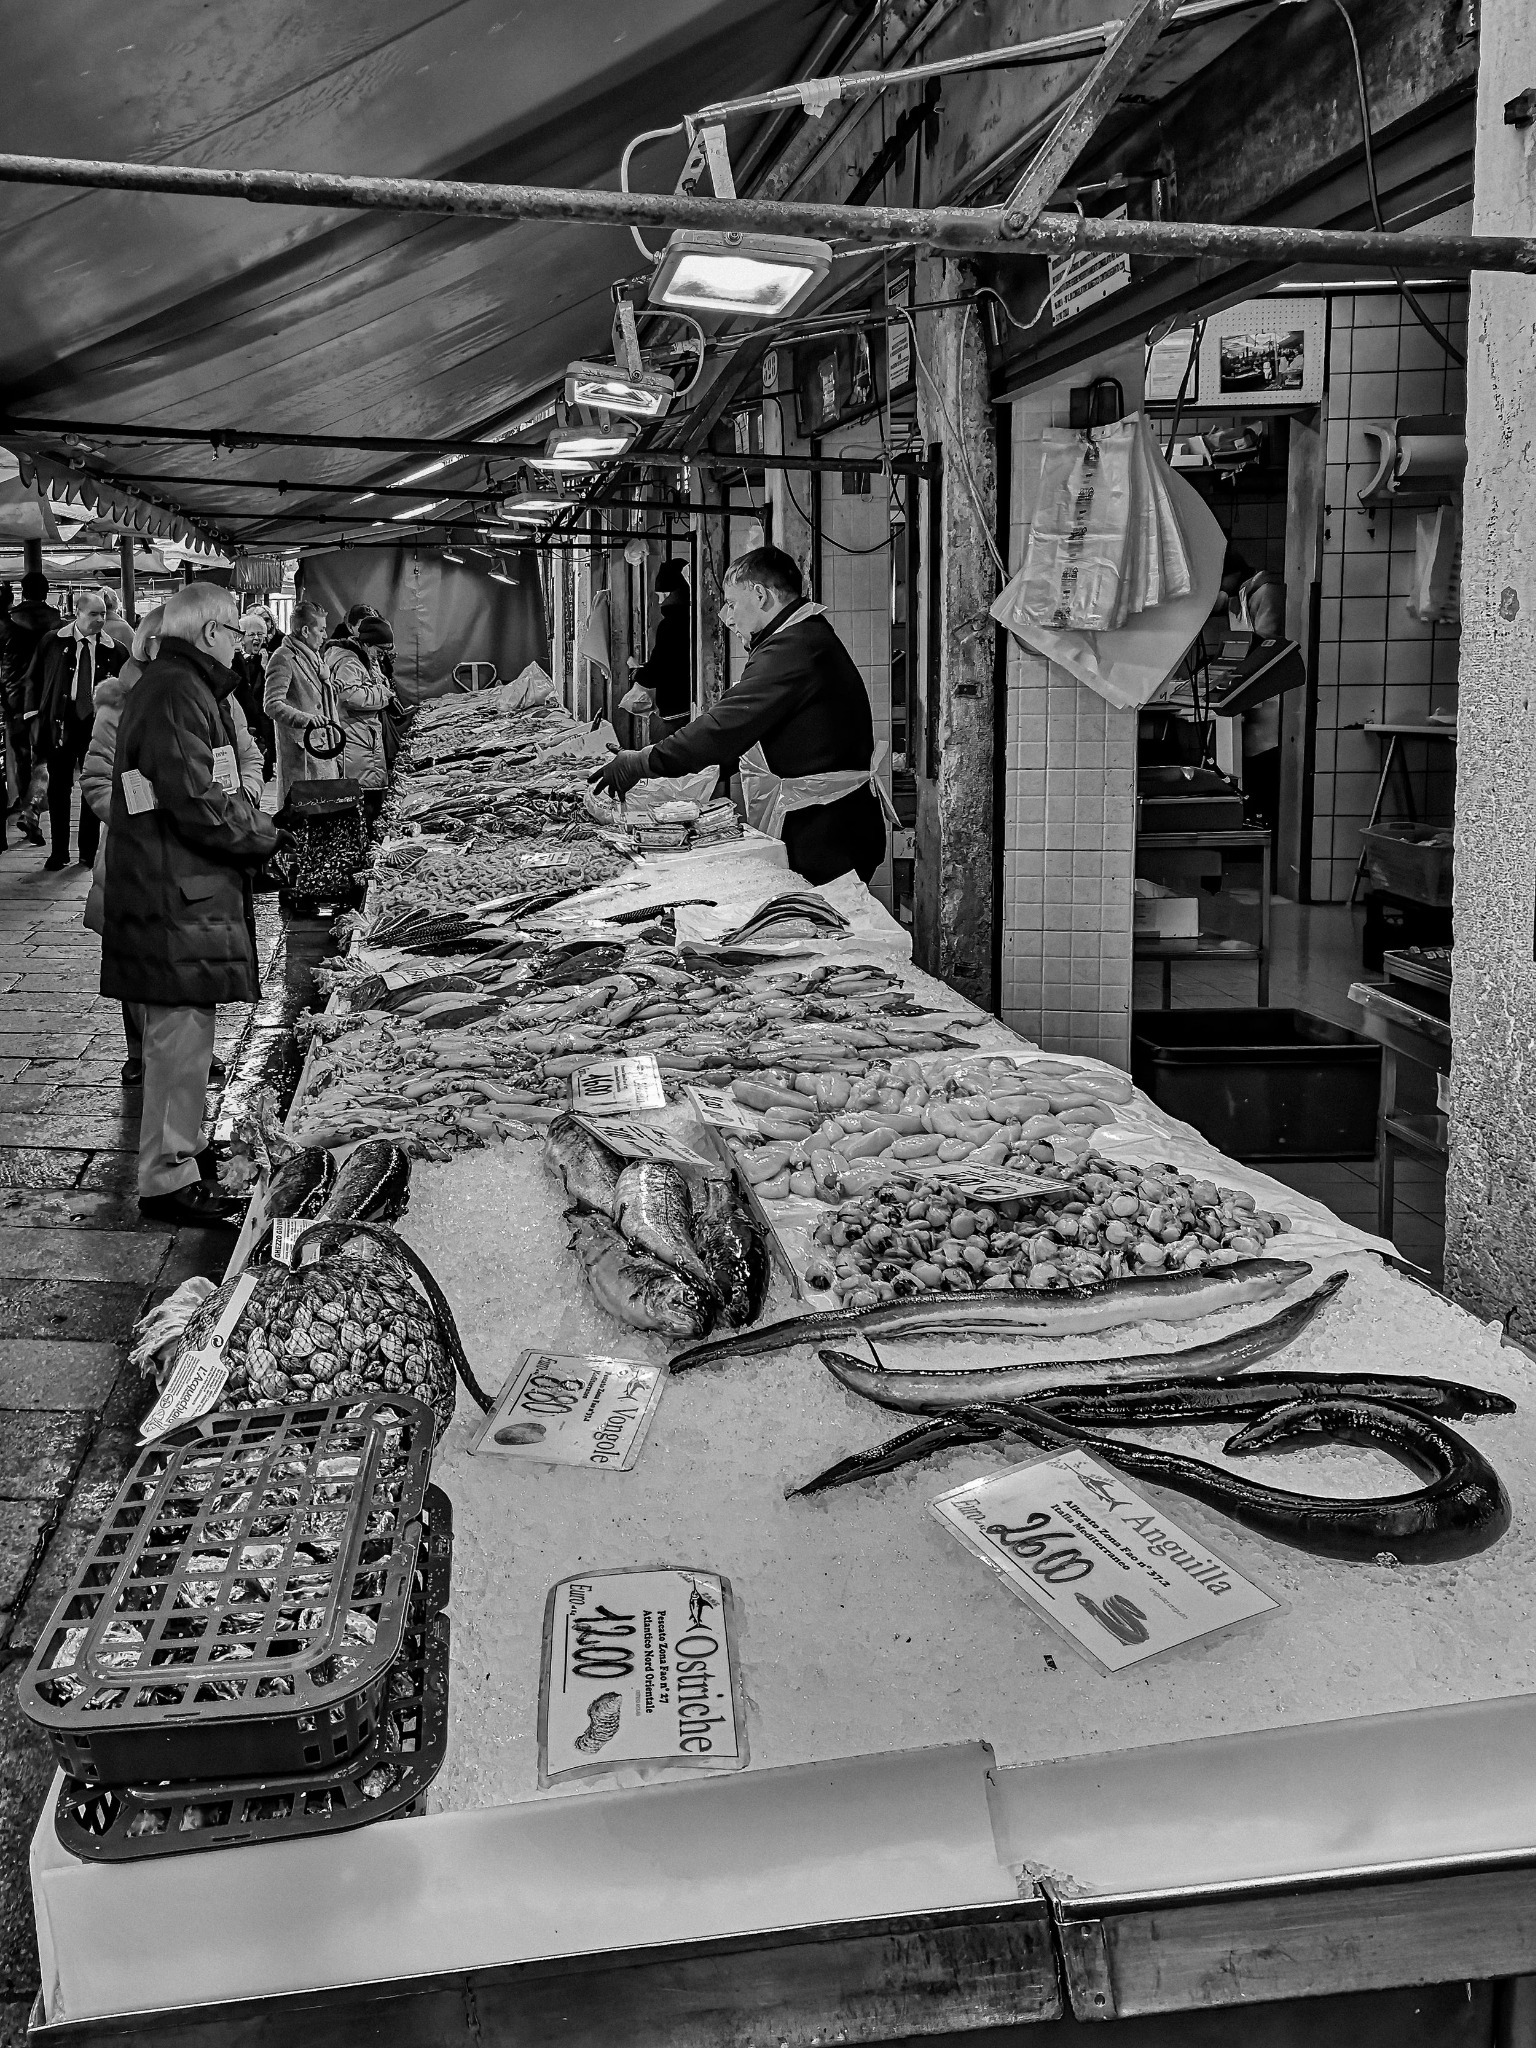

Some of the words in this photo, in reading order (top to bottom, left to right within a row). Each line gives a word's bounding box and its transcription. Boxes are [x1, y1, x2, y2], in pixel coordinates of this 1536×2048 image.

[536, 1356, 558, 1370] Euro
[589, 1399, 599, 1408] Fao
[593, 1388, 604, 1399] Zona
[589, 1407, 638, 1463] Vongole
[950, 1497, 986, 1521] Euro
[1050, 1504, 1076, 1523] Italia
[1072, 1522, 1132, 1571] Mediterraneo
[1062, 1499, 1102, 1529] Allevato
[1097, 1528, 1123, 1547] Zona
[1119, 1546, 1140, 1561] Fao
[1146, 1569, 1171, 1588] 37.2
[1120, 1512, 1232, 1595] Anguilla
[568, 1584, 591, 1604] Euro
[643, 1610, 652, 1648] Atlantico
[657, 1610, 666, 1641] Pescato
[644, 1650, 653, 1671] Nord
[658, 1642, 667, 1663] Zona
[659, 1665, 667, 1681] Fao
[645, 1673, 654, 1713] Orientale
[658, 1692, 668, 1703] 27
[675, 1636, 727, 1752] Ostriche
